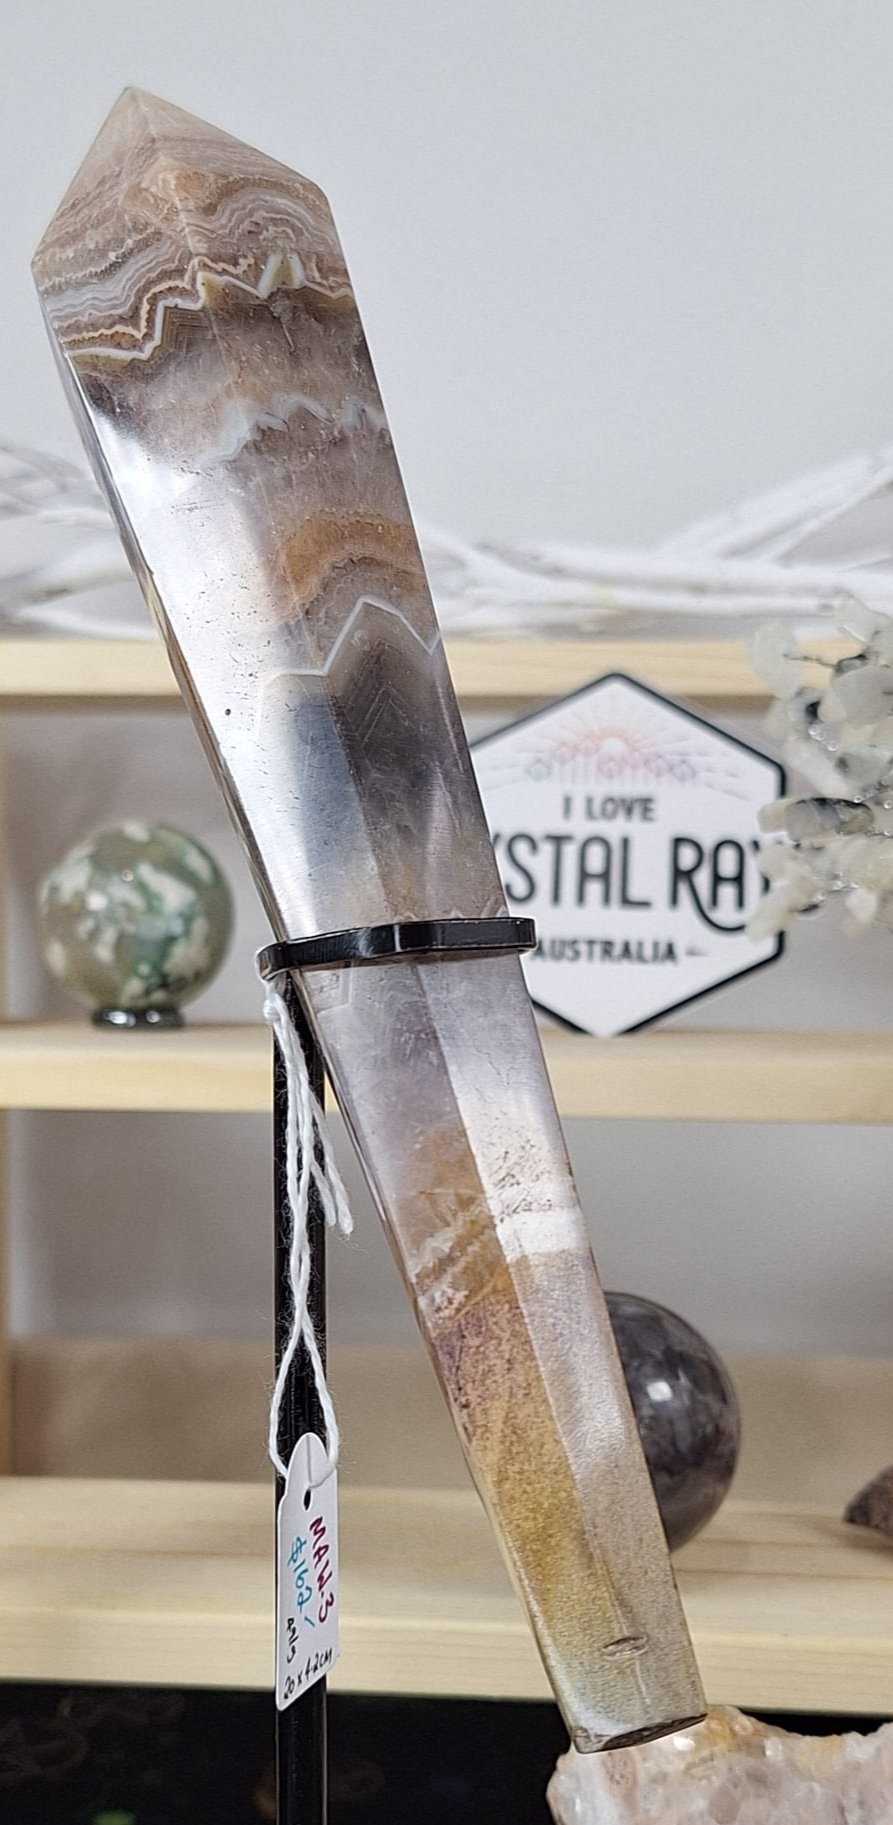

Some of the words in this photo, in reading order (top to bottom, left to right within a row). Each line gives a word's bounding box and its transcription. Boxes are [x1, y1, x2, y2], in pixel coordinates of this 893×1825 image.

[562, 796, 572, 821] I
[585, 797, 656, 822] LOVE
[493, 832, 653, 908] STAL
[530, 936, 679, 965] AUSTRALIA
